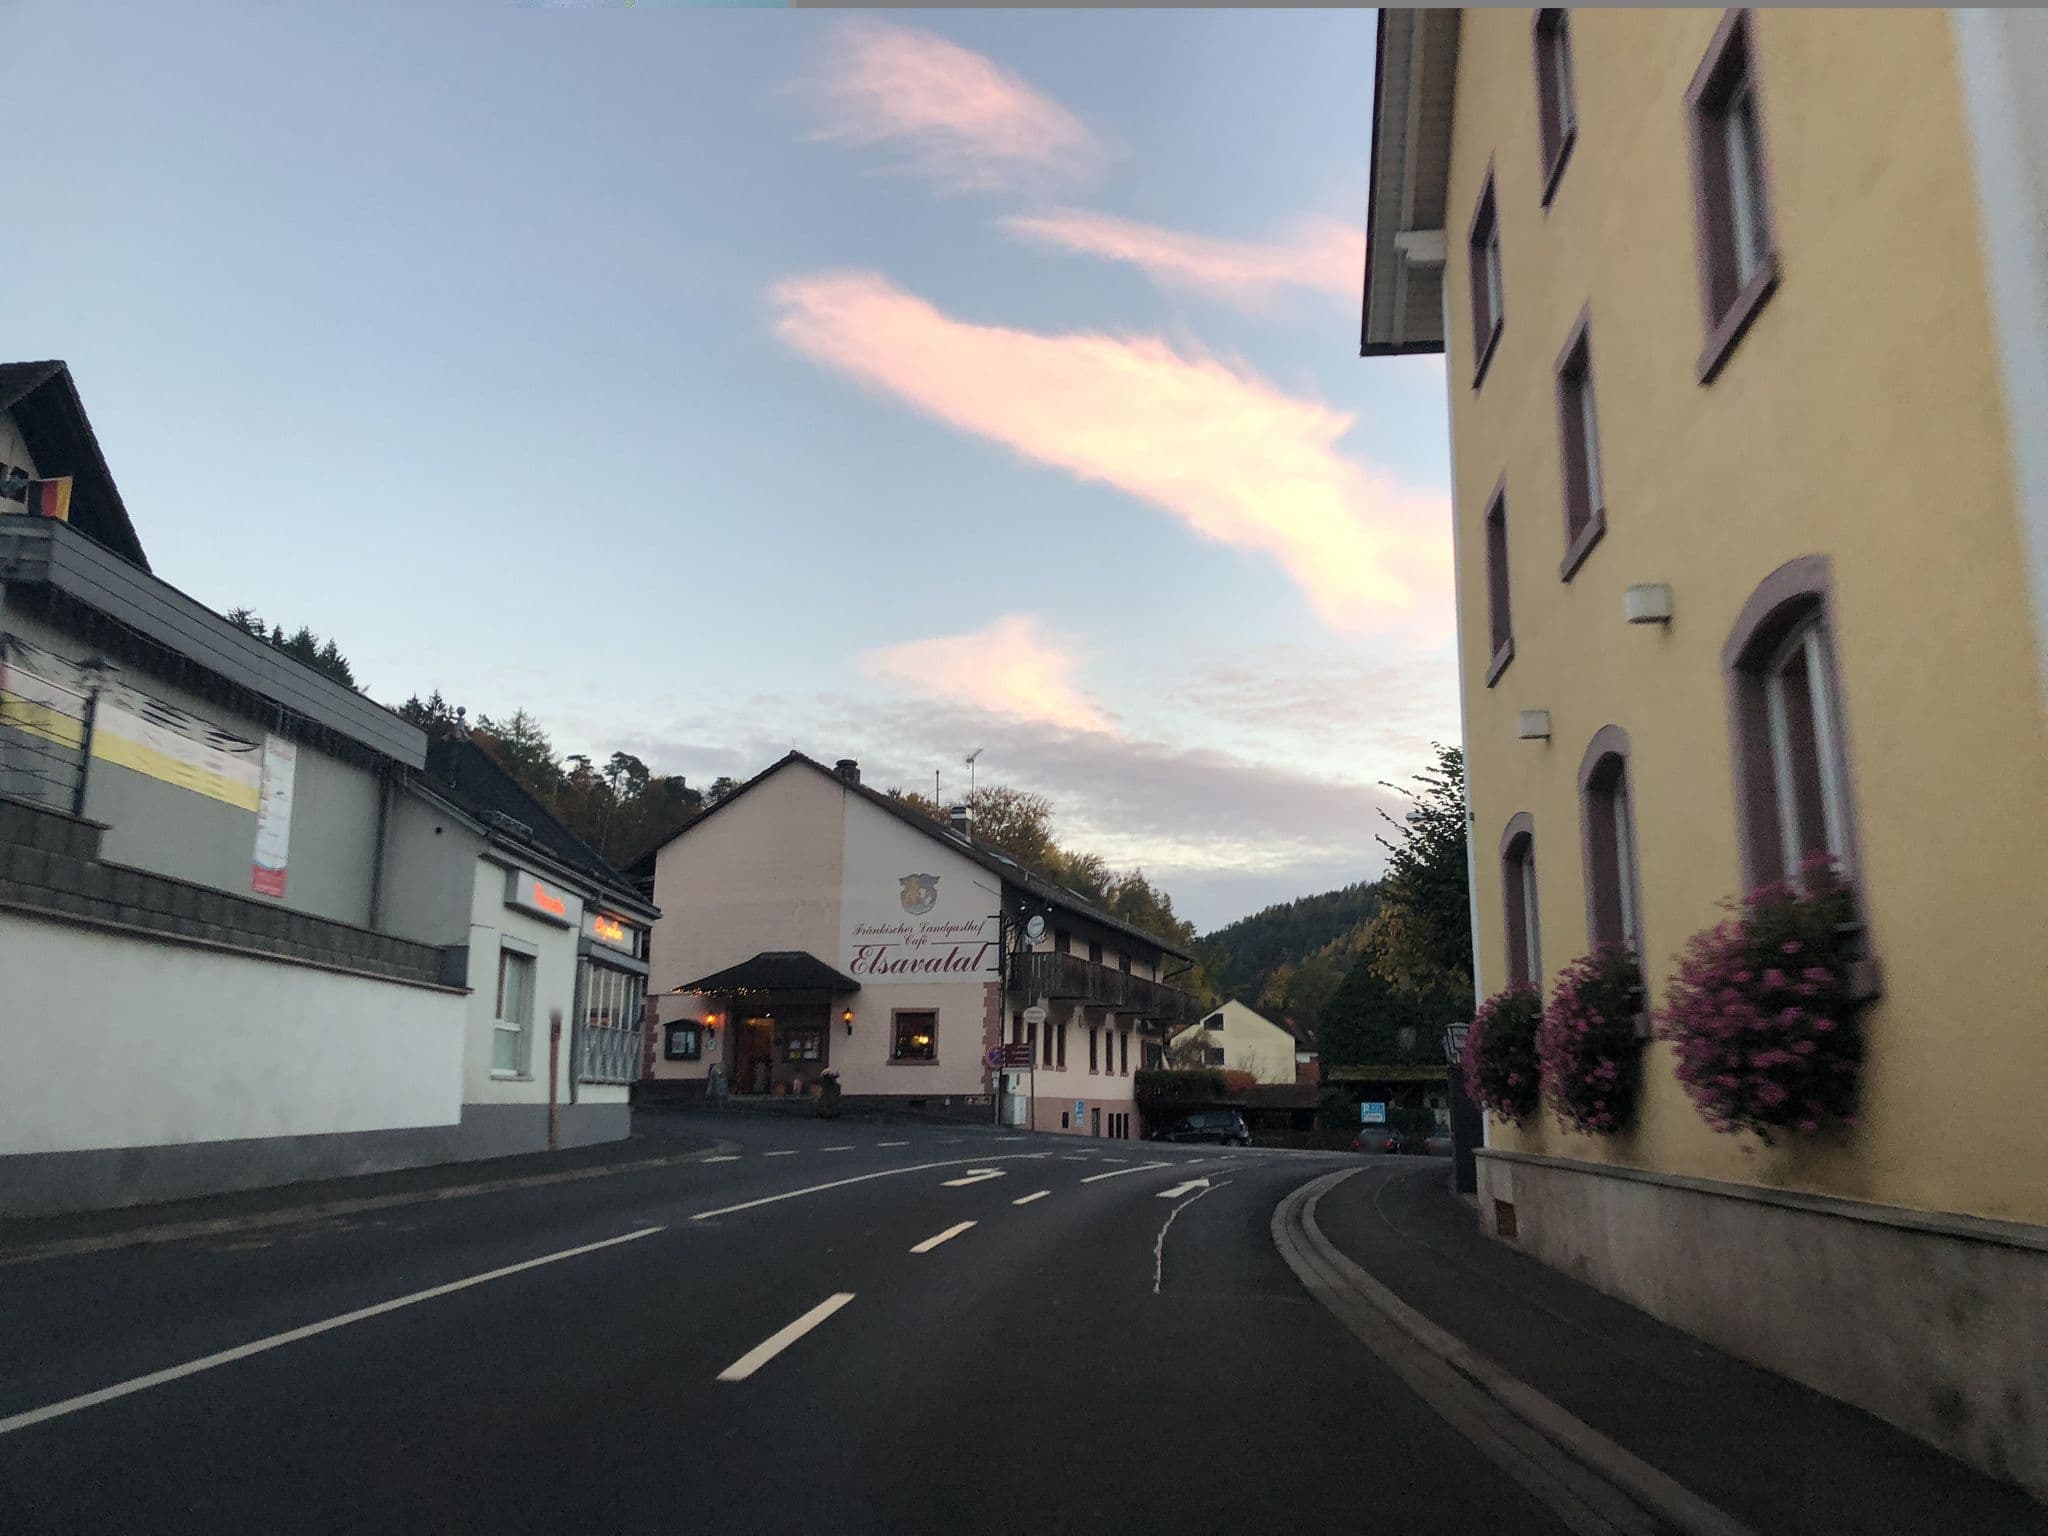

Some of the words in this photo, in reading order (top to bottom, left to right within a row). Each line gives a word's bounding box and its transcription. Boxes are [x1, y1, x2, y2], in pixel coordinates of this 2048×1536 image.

[852, 923, 914, 936] Fränkischer
[919, 920, 987, 938] Landgasthof
[904, 934, 928, 949] Café
[850, 943, 989, 974] Elsavatal
